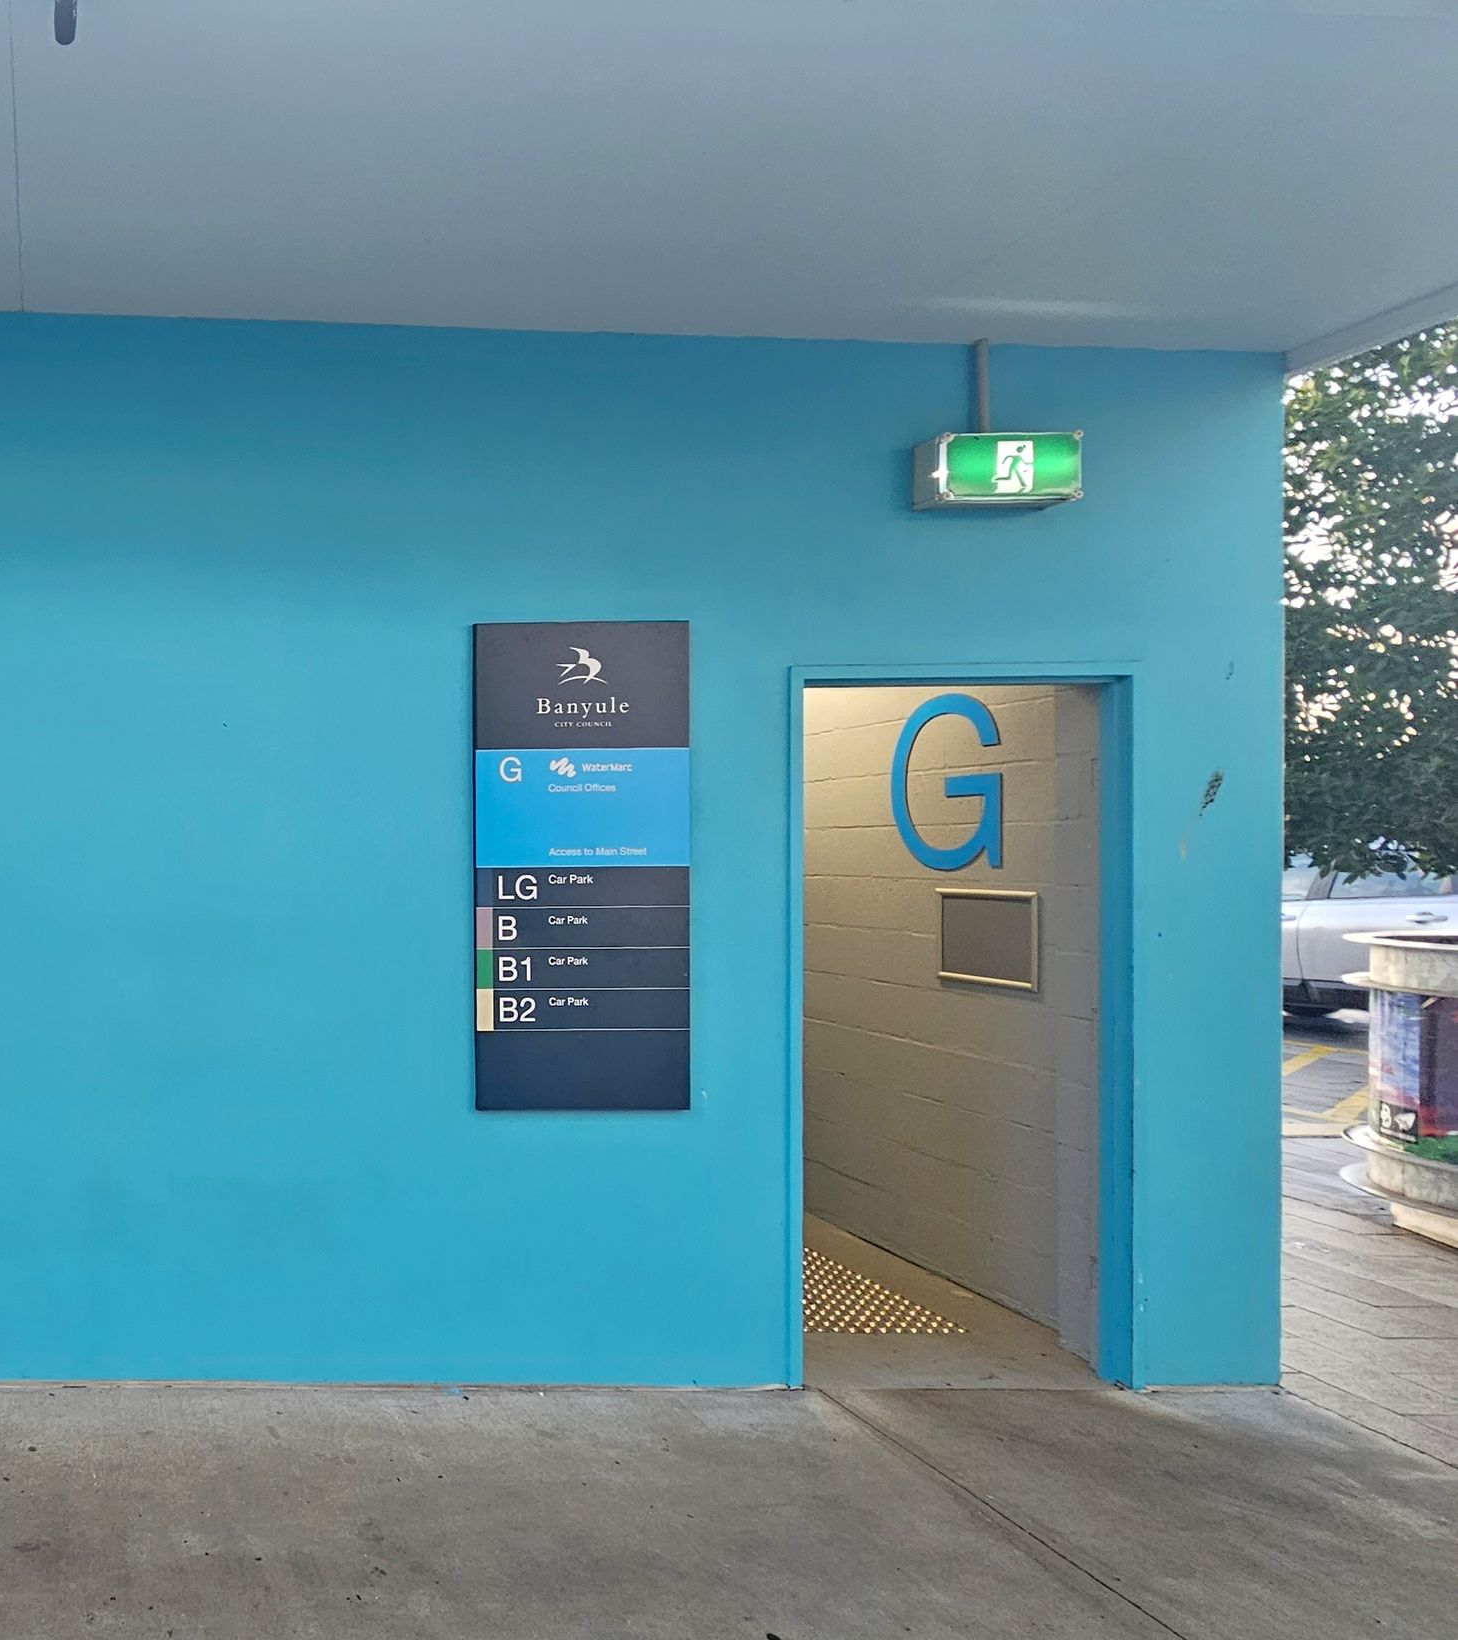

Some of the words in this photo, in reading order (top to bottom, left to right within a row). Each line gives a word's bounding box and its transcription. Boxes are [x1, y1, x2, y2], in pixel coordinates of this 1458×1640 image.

[537, 697, 629, 718] Banyule
[499, 756, 522, 782] G
[581, 763, 633, 772] WaterMarc
[548, 783, 582, 792] Council
[584, 783, 616, 792] Offices
[890, 692, 1001, 871] G
[548, 847, 582, 856] Access
[584, 847, 594, 856] to
[595, 847, 618, 856] Main
[619, 846, 648, 856] Street
[548, 874, 567, 884] Car
[569, 874, 594, 884] Park
[498, 875, 538, 900] LG
[548, 916, 565, 925] Car
[567, 915, 588, 924] Park
[498, 916, 517, 941] B
[548, 957, 565, 966] Car
[567, 956, 588, 966] Park
[498, 957, 531, 981] B1
[499, 997, 536, 1022] B2
[548, 997, 565, 1007] Car
[567, 997, 589, 1006] Park
